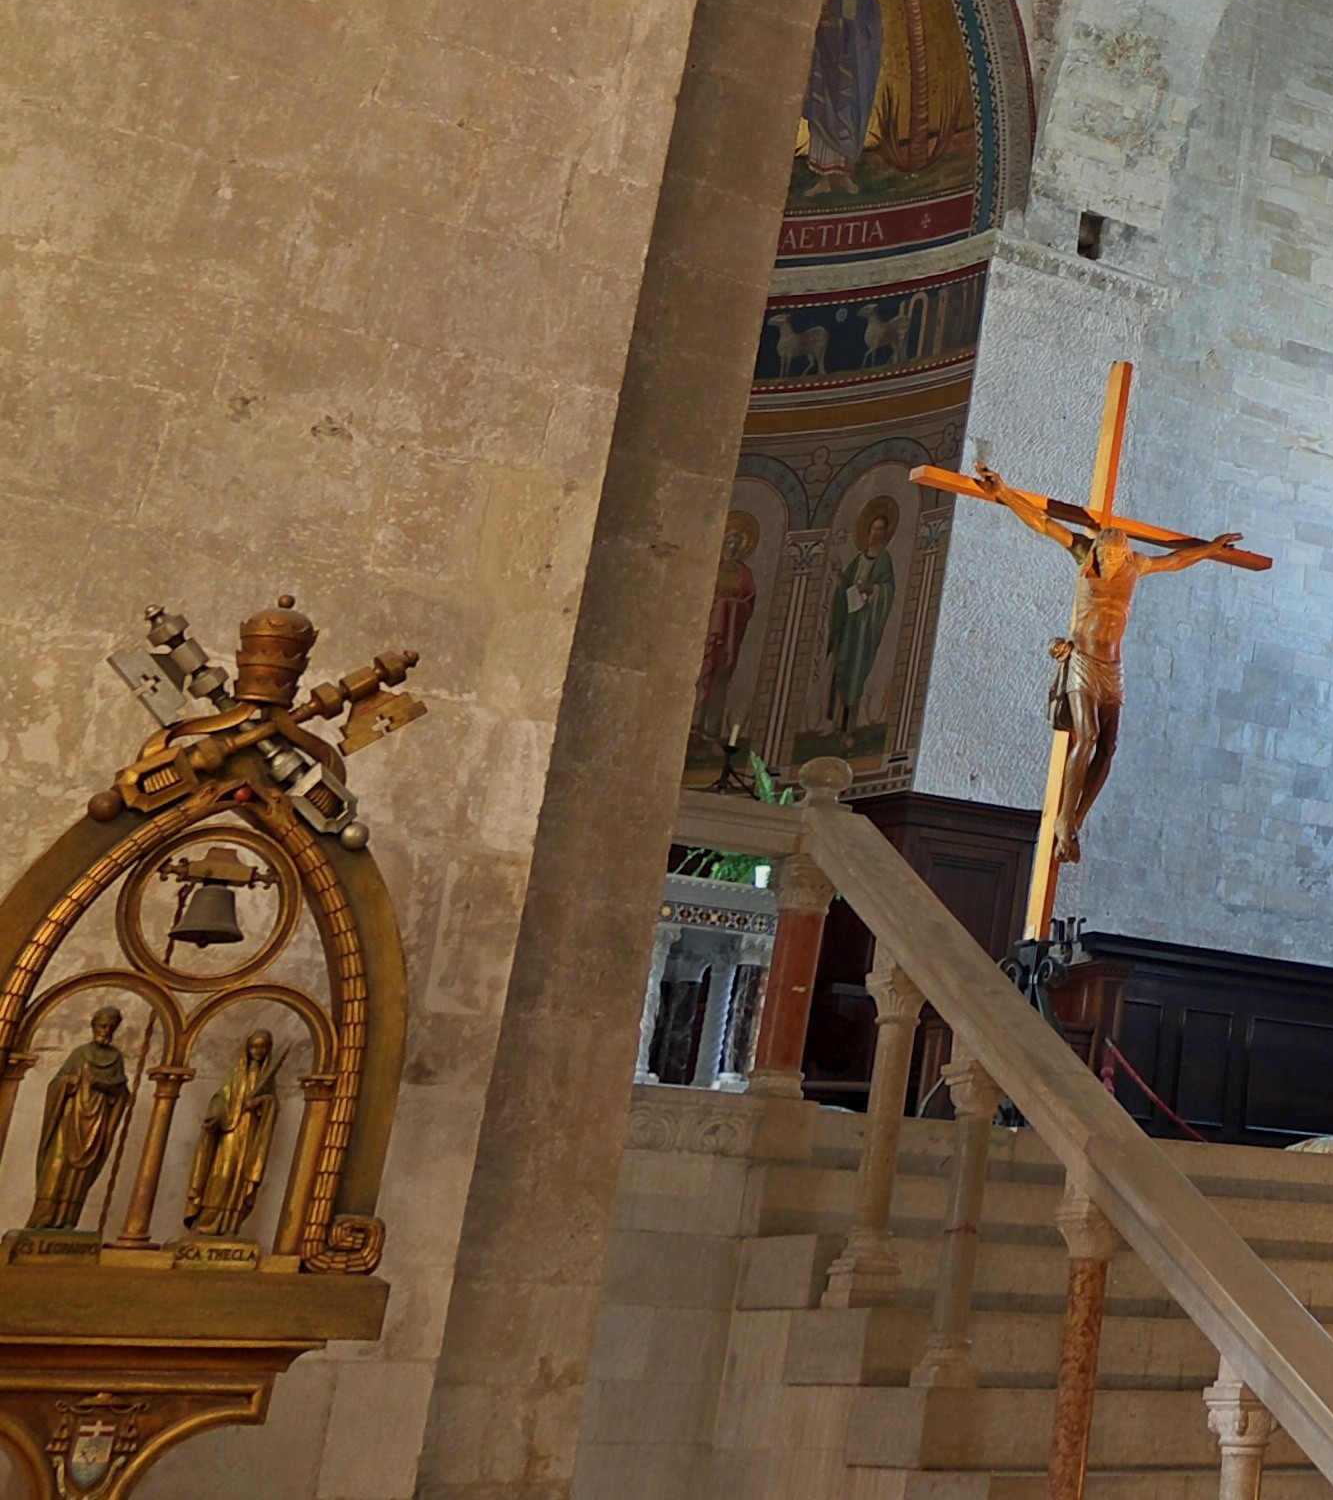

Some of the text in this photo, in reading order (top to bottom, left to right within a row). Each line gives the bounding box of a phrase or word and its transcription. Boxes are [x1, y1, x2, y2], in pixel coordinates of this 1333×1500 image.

[778, 219, 884, 250] AETITIA
[176, 1246, 257, 1262] SCA THECLA
